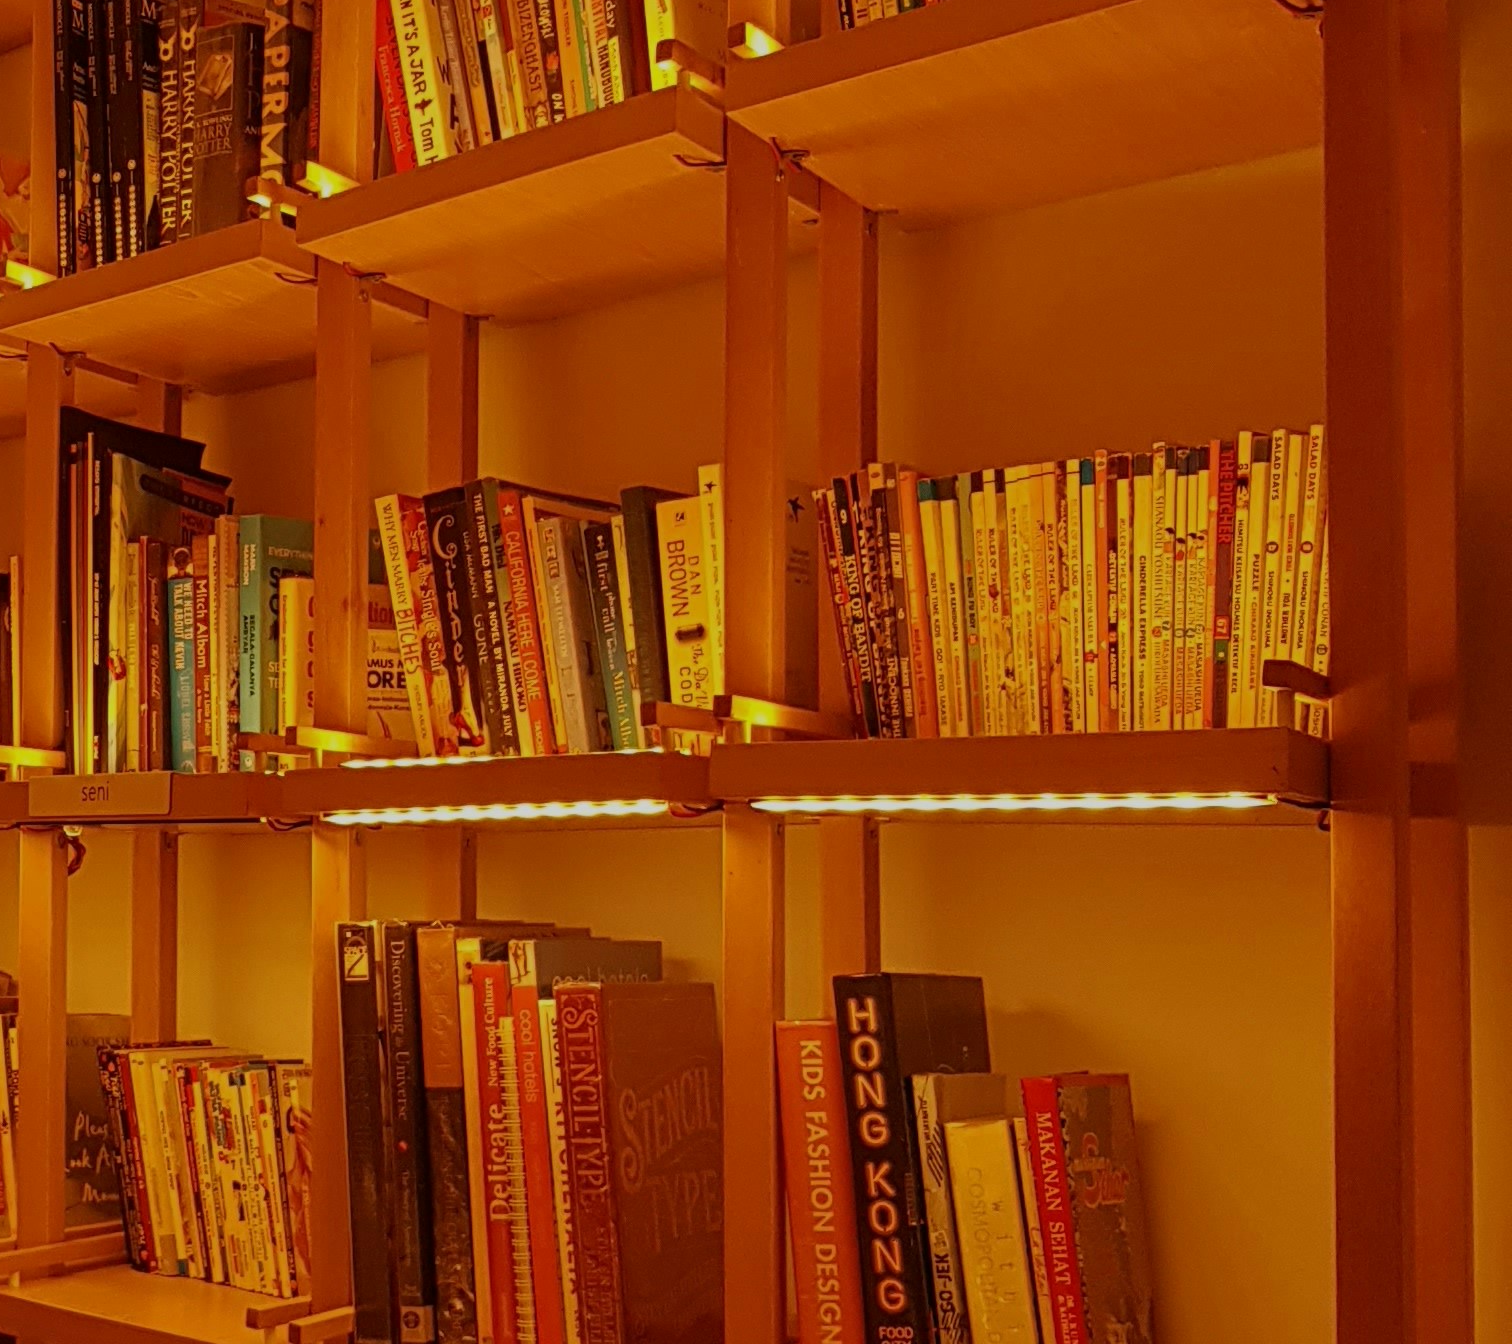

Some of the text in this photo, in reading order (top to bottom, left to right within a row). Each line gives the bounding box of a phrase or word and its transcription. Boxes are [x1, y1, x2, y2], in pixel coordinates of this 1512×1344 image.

[399, 9, 418, 42] IT'S
[405, 44, 420, 55] A
[516, 0, 542, 93] BIZENGHAST
[605, 0, 618, 28] day
[180, 60, 196, 138] HARRY
[378, 47, 404, 152] Francesca Hornak
[406, 56, 429, 95] JAR
[160, 68, 179, 230] HARRY POTTER
[418, 117, 434, 151] Tom
[473, 492, 482, 513] THE
[1218, 450, 1235, 545] THE PITCHER
[1272, 436, 1284, 501] SALAD DAYS
[1307, 435, 1321, 500] SALAD DAYS
[475, 515, 486, 543] FIRST
[479, 545, 489, 567] BAD
[243, 544, 257, 586] MARK MANSON
[383, 503, 420, 674] WHY MEN MARRY BITCHES
[482, 569, 493, 593] MAN
[666, 539, 702, 616] DAN BROWN
[1251, 554, 1259, 592] PUZZLE
[173, 583, 186, 669] TALK ABOUT KEVIN
[182, 582, 193, 639] WE NEED TO
[197, 580, 208, 668] Mitch Albom
[473, 614, 489, 665] GONE
[488, 609, 500, 644] NOVEL
[502, 531, 539, 703] CALIFORNIA HERE COME
[597, 559, 629, 713] first call Mitch
[845, 555, 871, 682] KING OF BANDIT
[1138, 555, 1147, 660] CINDERELLA EXPRESS
[429, 641, 443, 672] Soul
[494, 662, 509, 710] MIRANDA
[504, 601, 528, 712] NAMAKU HIROKO
[692, 644, 703, 667] The
[503, 713, 513, 737] JULY
[81, 781, 110, 802] seni
[391, 939, 410, 1120] Discovering Universe
[483, 976, 499, 1088] New Food Culture
[518, 1010, 538, 1104] cool hotels
[561, 1000, 601, 1122] STENCIL
[800, 1039, 826, 1102] KIDS
[618, 1064, 720, 1189] STENCIL
[846, 996, 909, 1316] HONG KONG
[489, 1102, 512, 1223] Delicate
[806, 1110, 836, 1233] FASHION
[1035, 1110, 1072, 1287] MAKANAN SEHAT
[878, 1326, 915, 1340] FOOD
